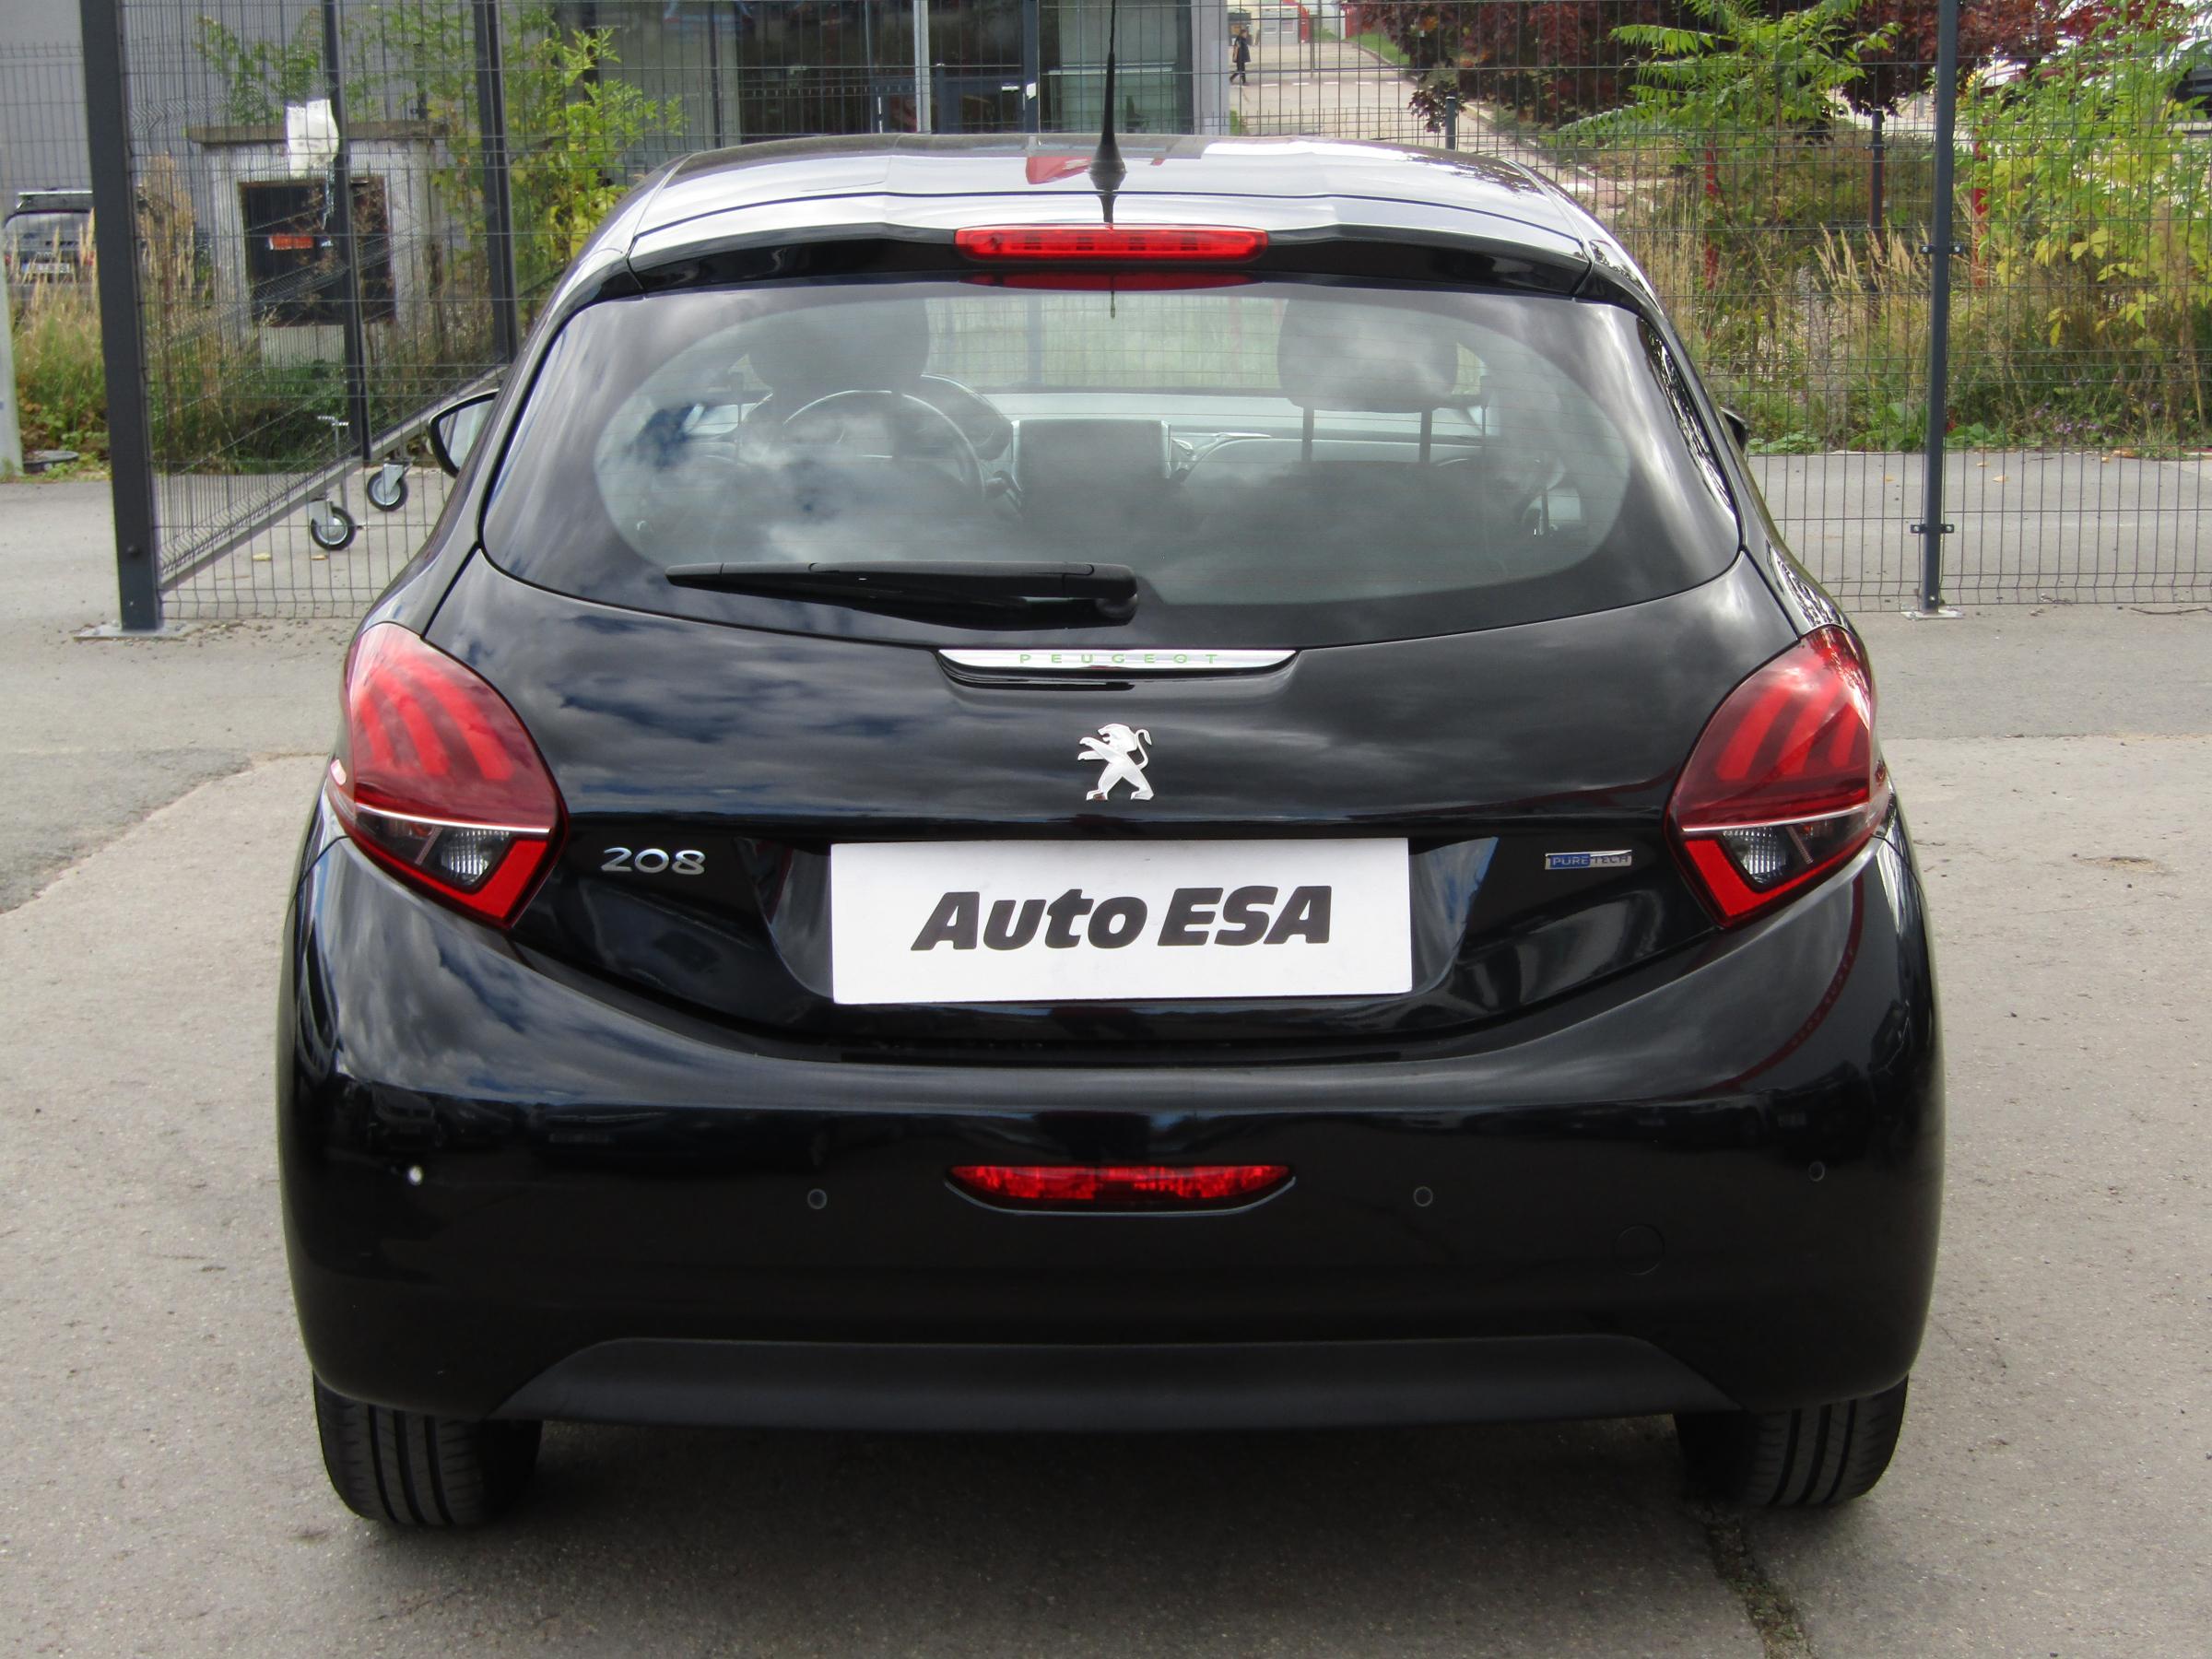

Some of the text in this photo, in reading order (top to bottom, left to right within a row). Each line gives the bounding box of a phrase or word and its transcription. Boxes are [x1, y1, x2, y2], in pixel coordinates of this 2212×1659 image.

[1019, 653, 1218, 665] PEUGEOT
[601, 846, 706, 875] 208
[911, 886, 1332, 950] Auto ESA
